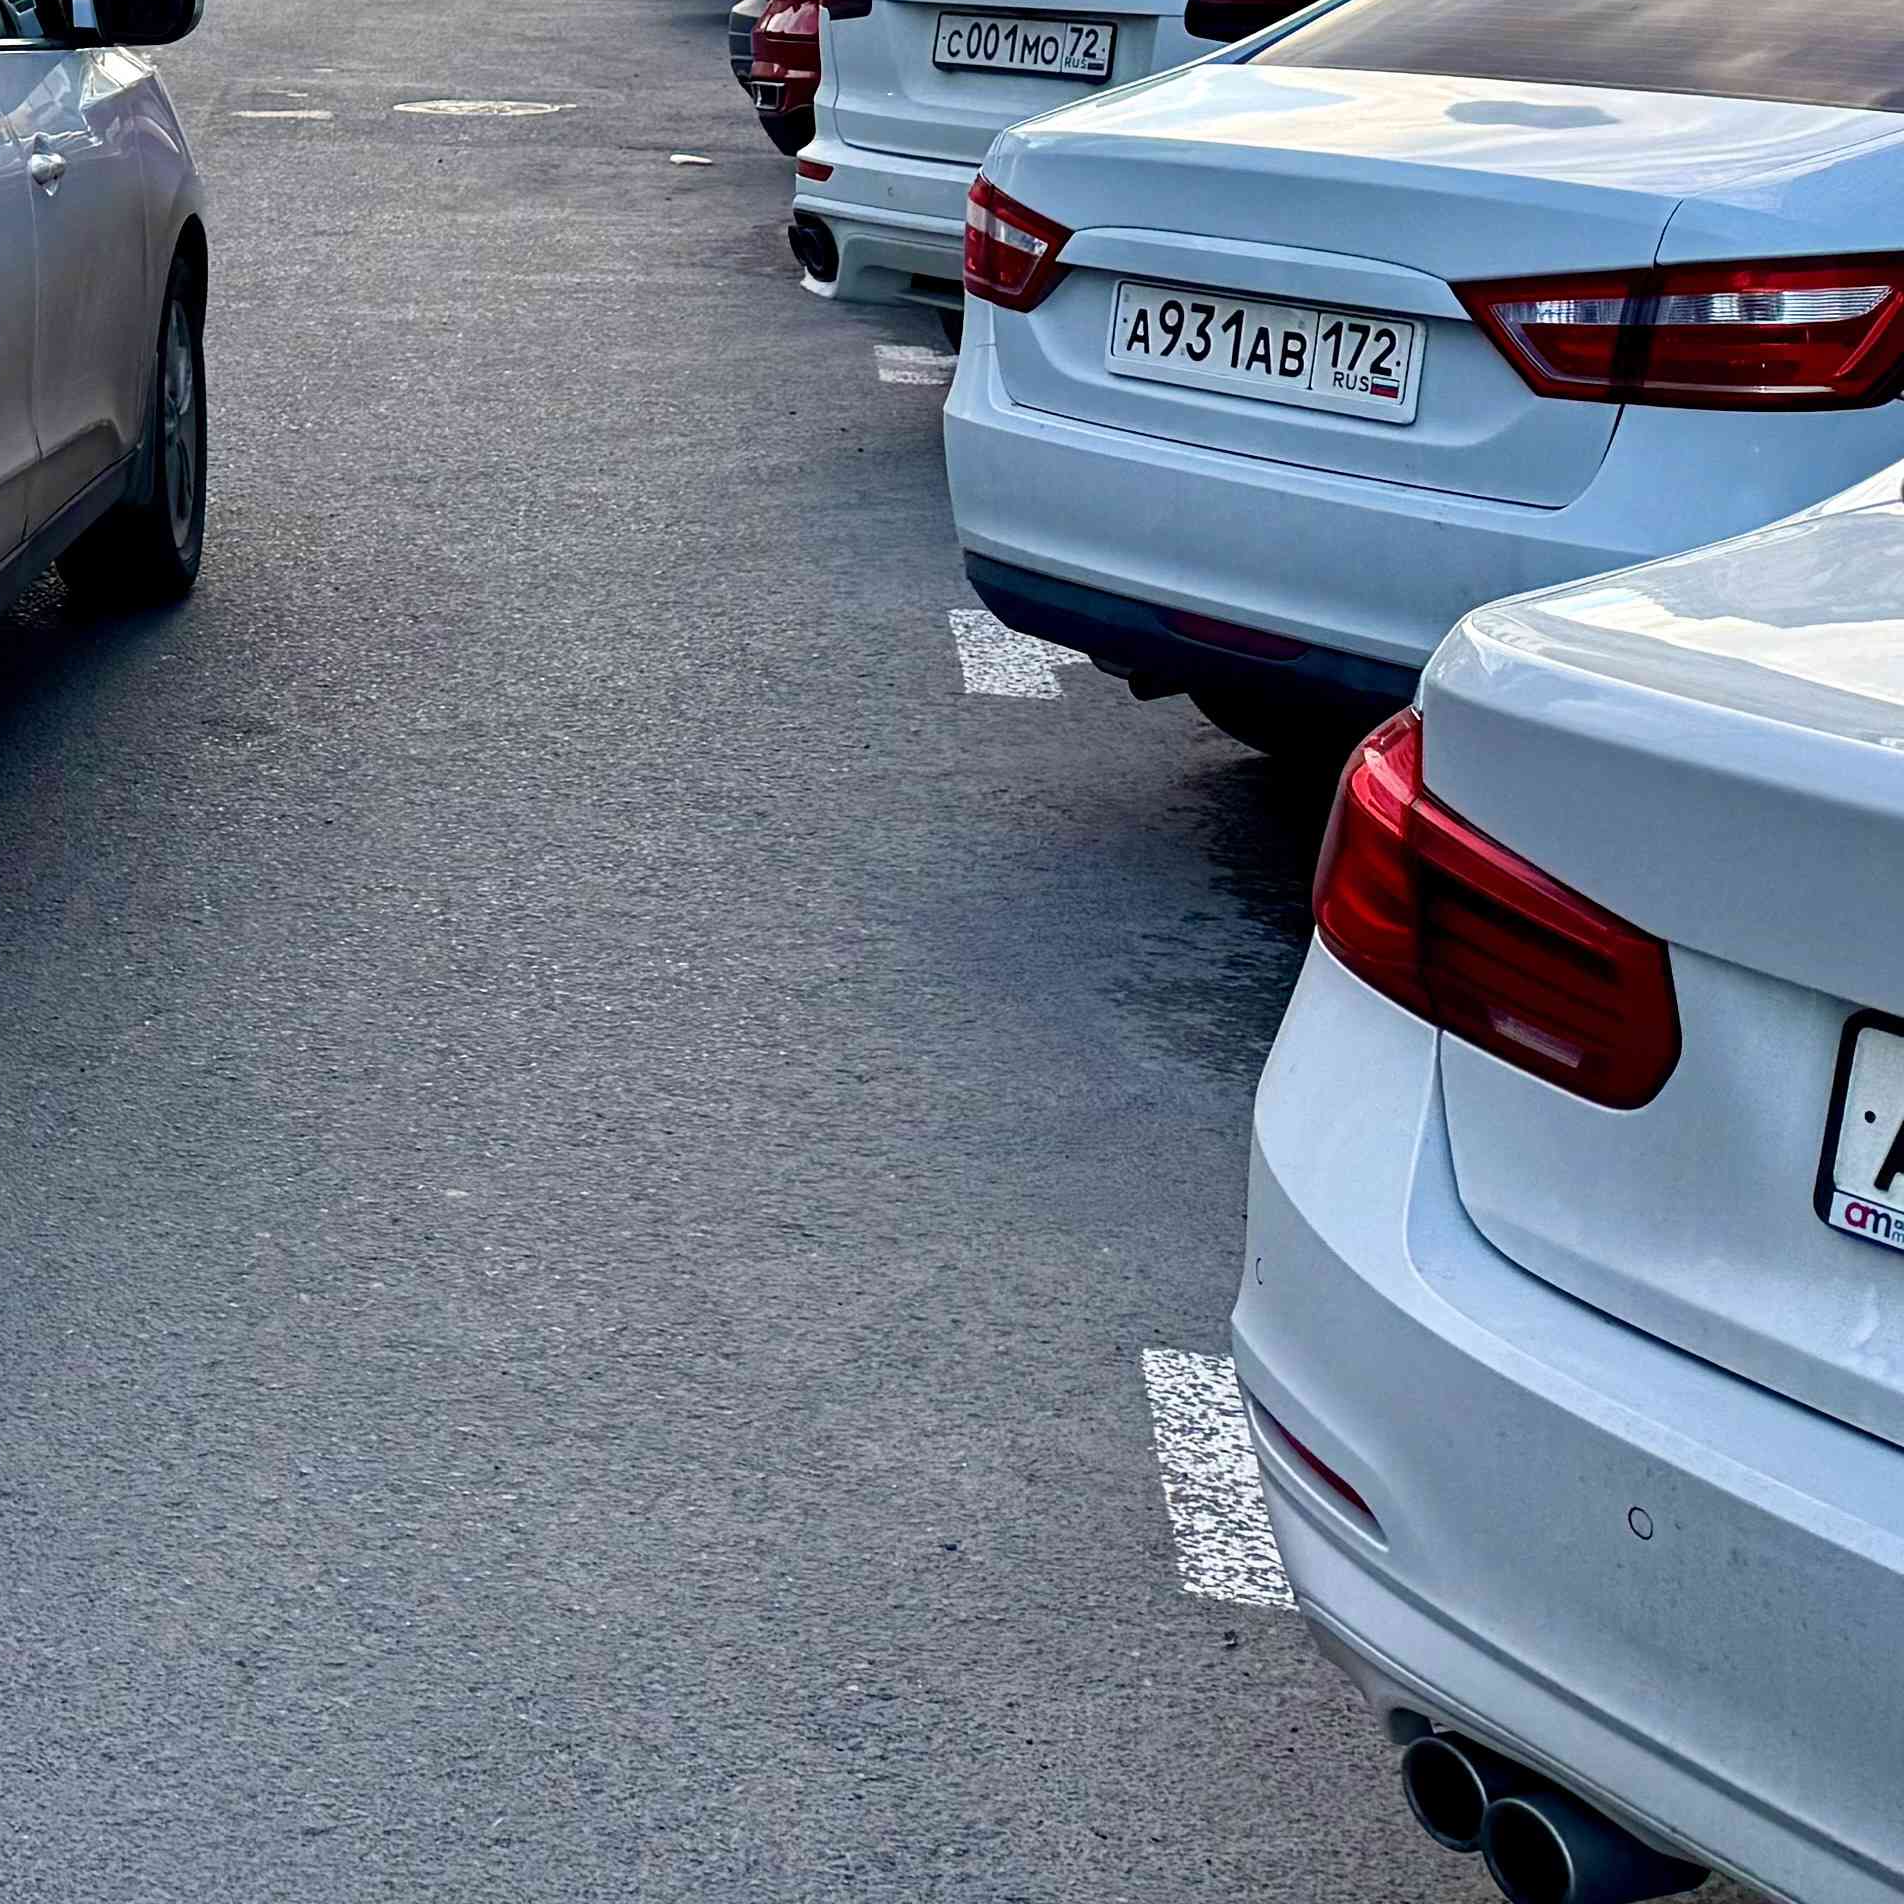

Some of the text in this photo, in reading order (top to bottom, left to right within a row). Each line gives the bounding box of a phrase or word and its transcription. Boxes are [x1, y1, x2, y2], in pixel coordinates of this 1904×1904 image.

[947, 21, 1099, 65] С001МО 72
[1064, 56, 1088, 70] RUS
[1126, 299, 1397, 378] А931АВ 172
[1332, 371, 1370, 393] RUS
